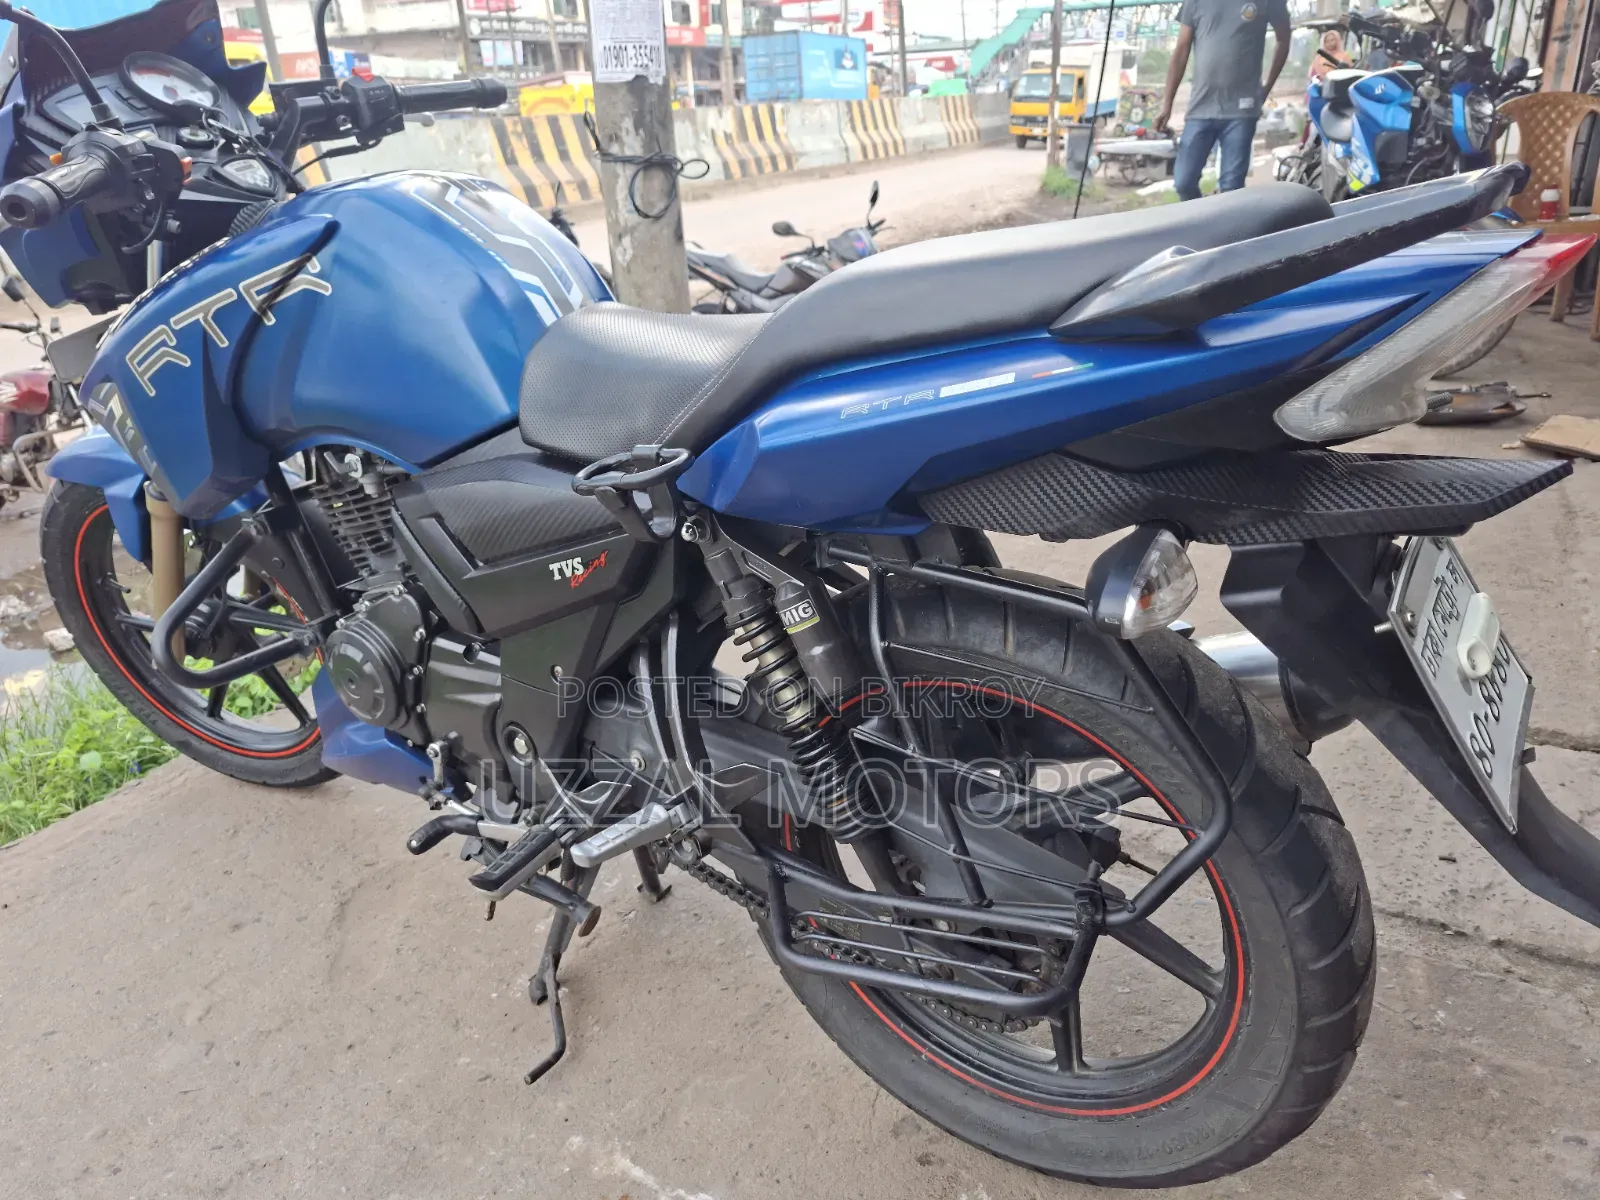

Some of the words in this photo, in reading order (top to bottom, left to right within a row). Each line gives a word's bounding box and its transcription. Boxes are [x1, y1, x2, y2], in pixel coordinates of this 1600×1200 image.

[125, 252, 332, 397] RTR
[840, 389, 935, 419] RTR
[548, 556, 585, 581] TVS
[570, 549, 609, 589] Racing
[780, 602, 814, 626] MIG
[1421, 618, 1445, 679] ঢাকা
